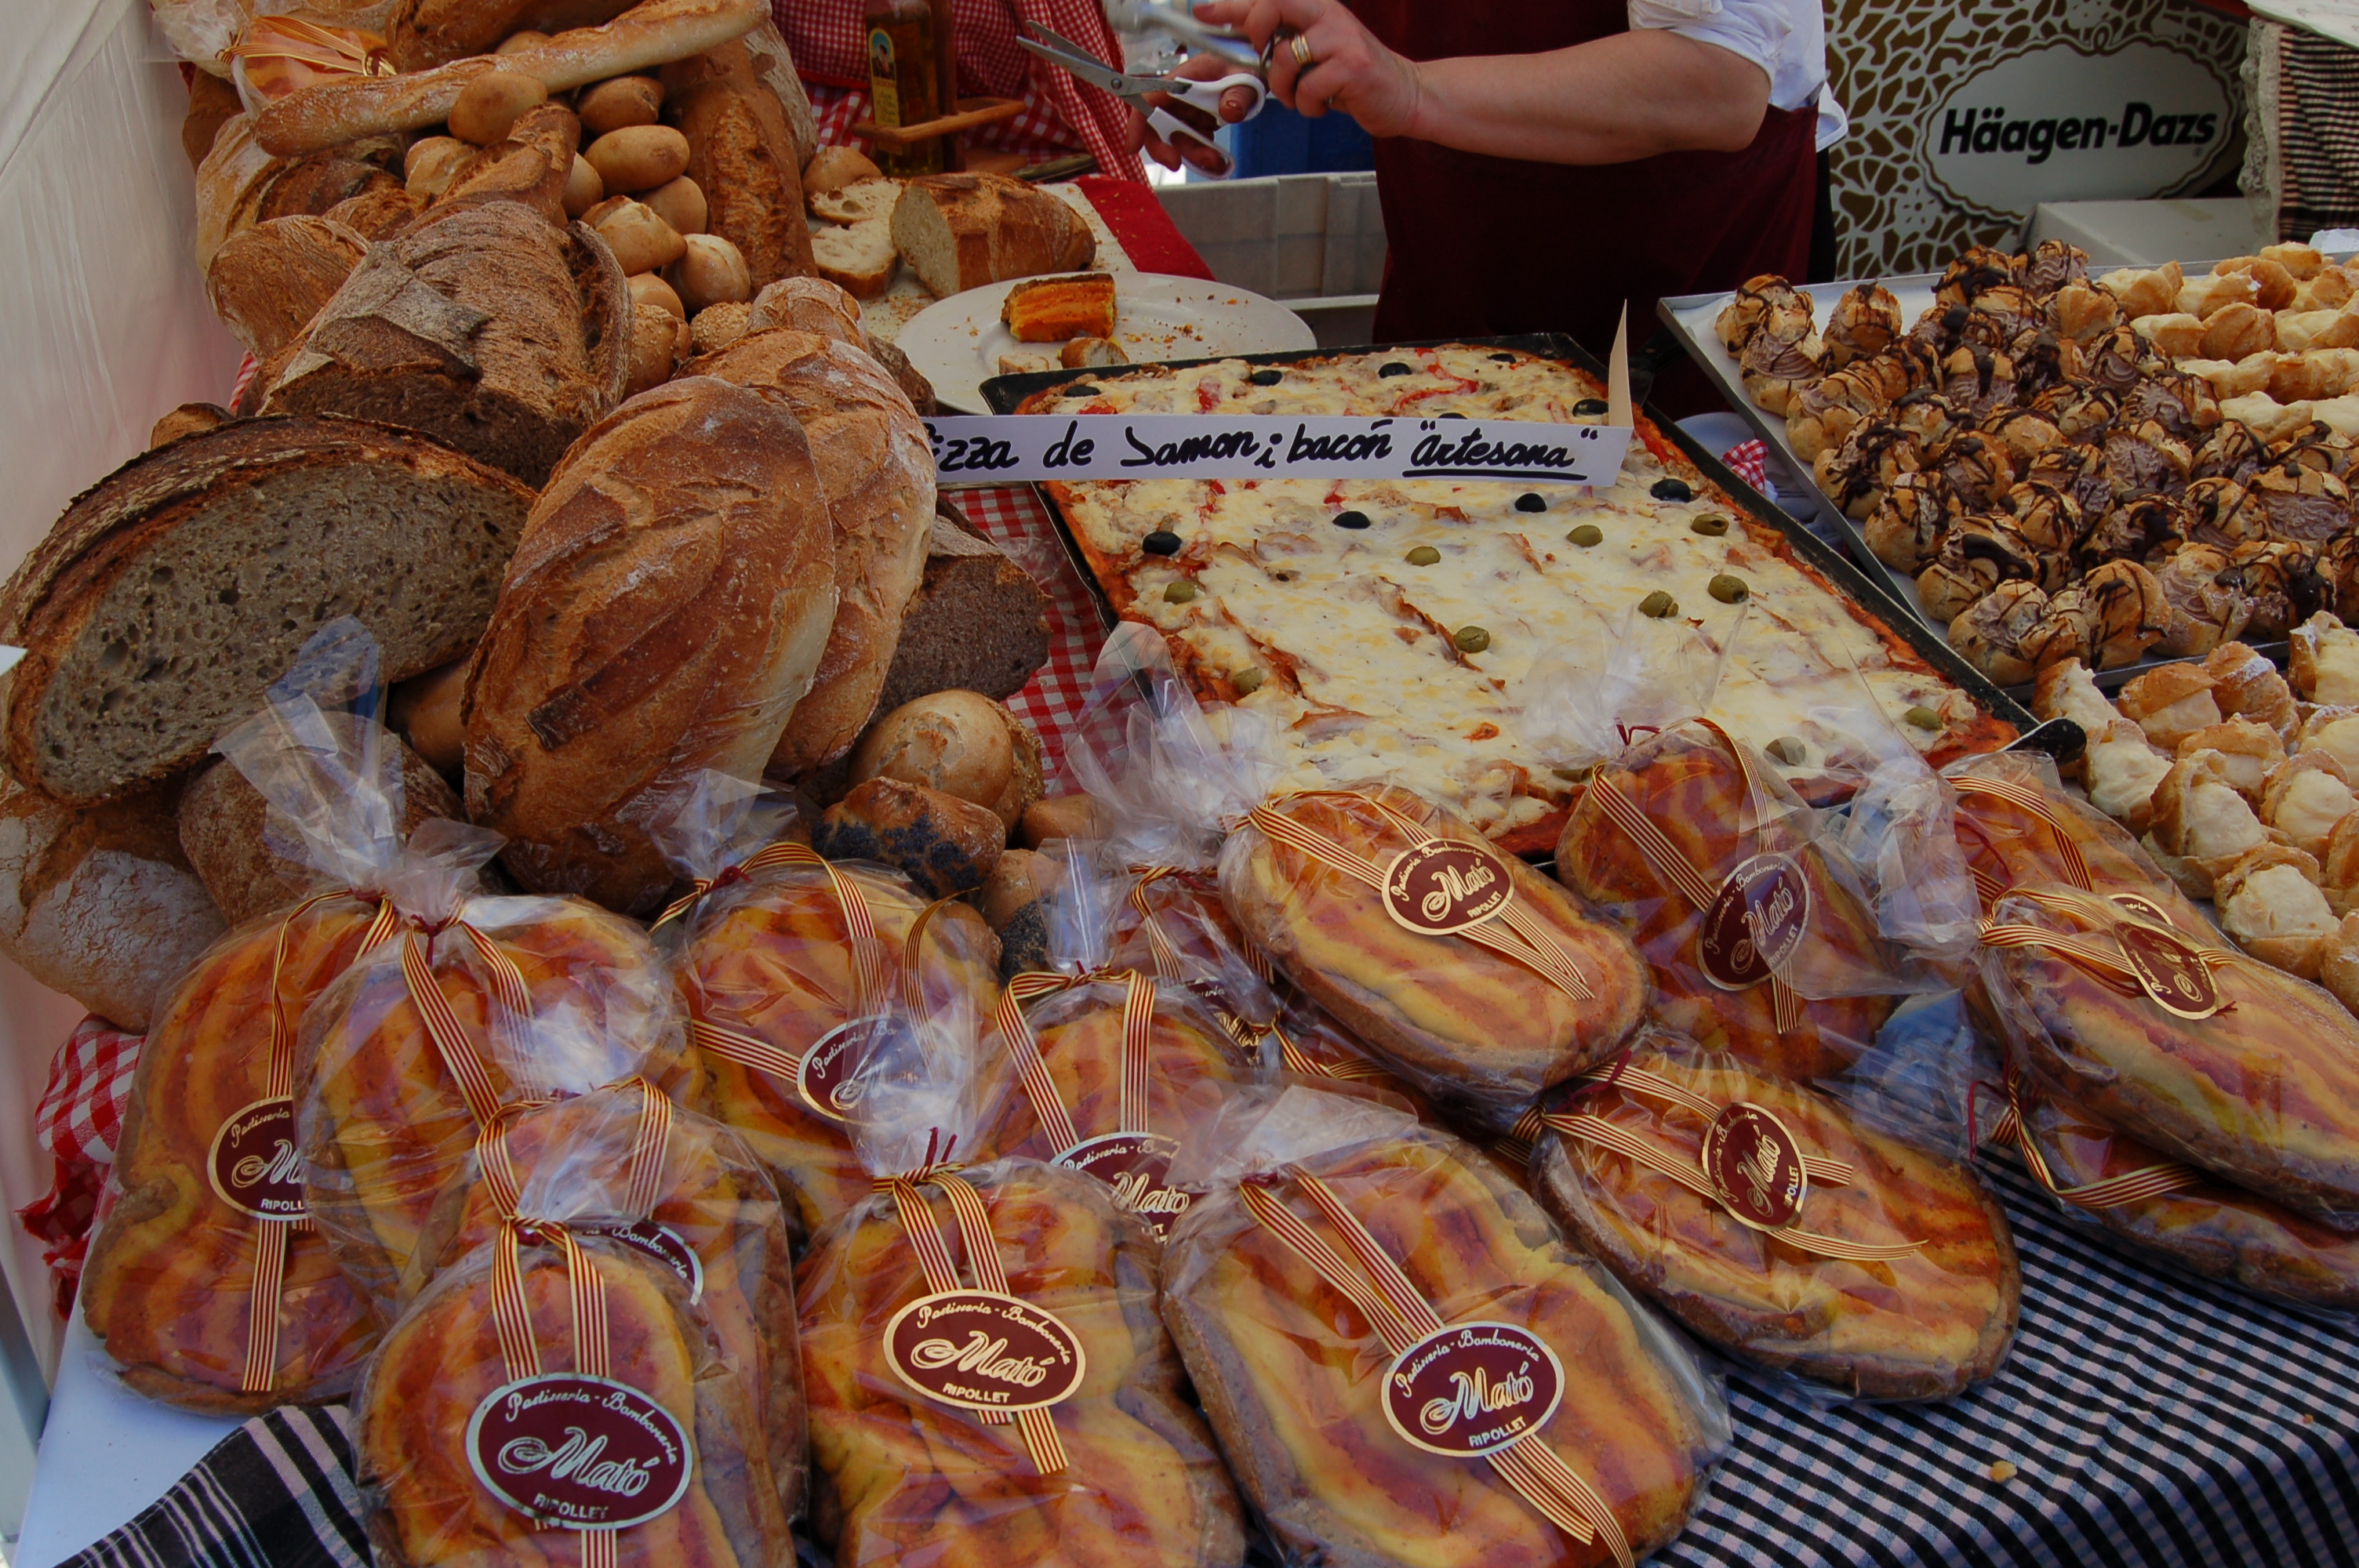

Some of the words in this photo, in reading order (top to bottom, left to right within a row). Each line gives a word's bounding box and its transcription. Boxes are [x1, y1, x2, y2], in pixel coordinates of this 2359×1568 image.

[1939, 102, 2218, 165] Häagen-Dazs
[922, 422, 1020, 473] izza
[1042, 419, 1096, 469] de
[1466, 890, 1503, 919] RIPOLLET
[1767, 923, 1799, 967] RIPOLLET
[260, 1197, 305, 1211] RIPOLL
[943, 1382, 1011, 1403] RIPOLLET
[1468, 1415, 1528, 1447] RIPOLLET
[533, 1492, 609, 1519] RIPOLLET
